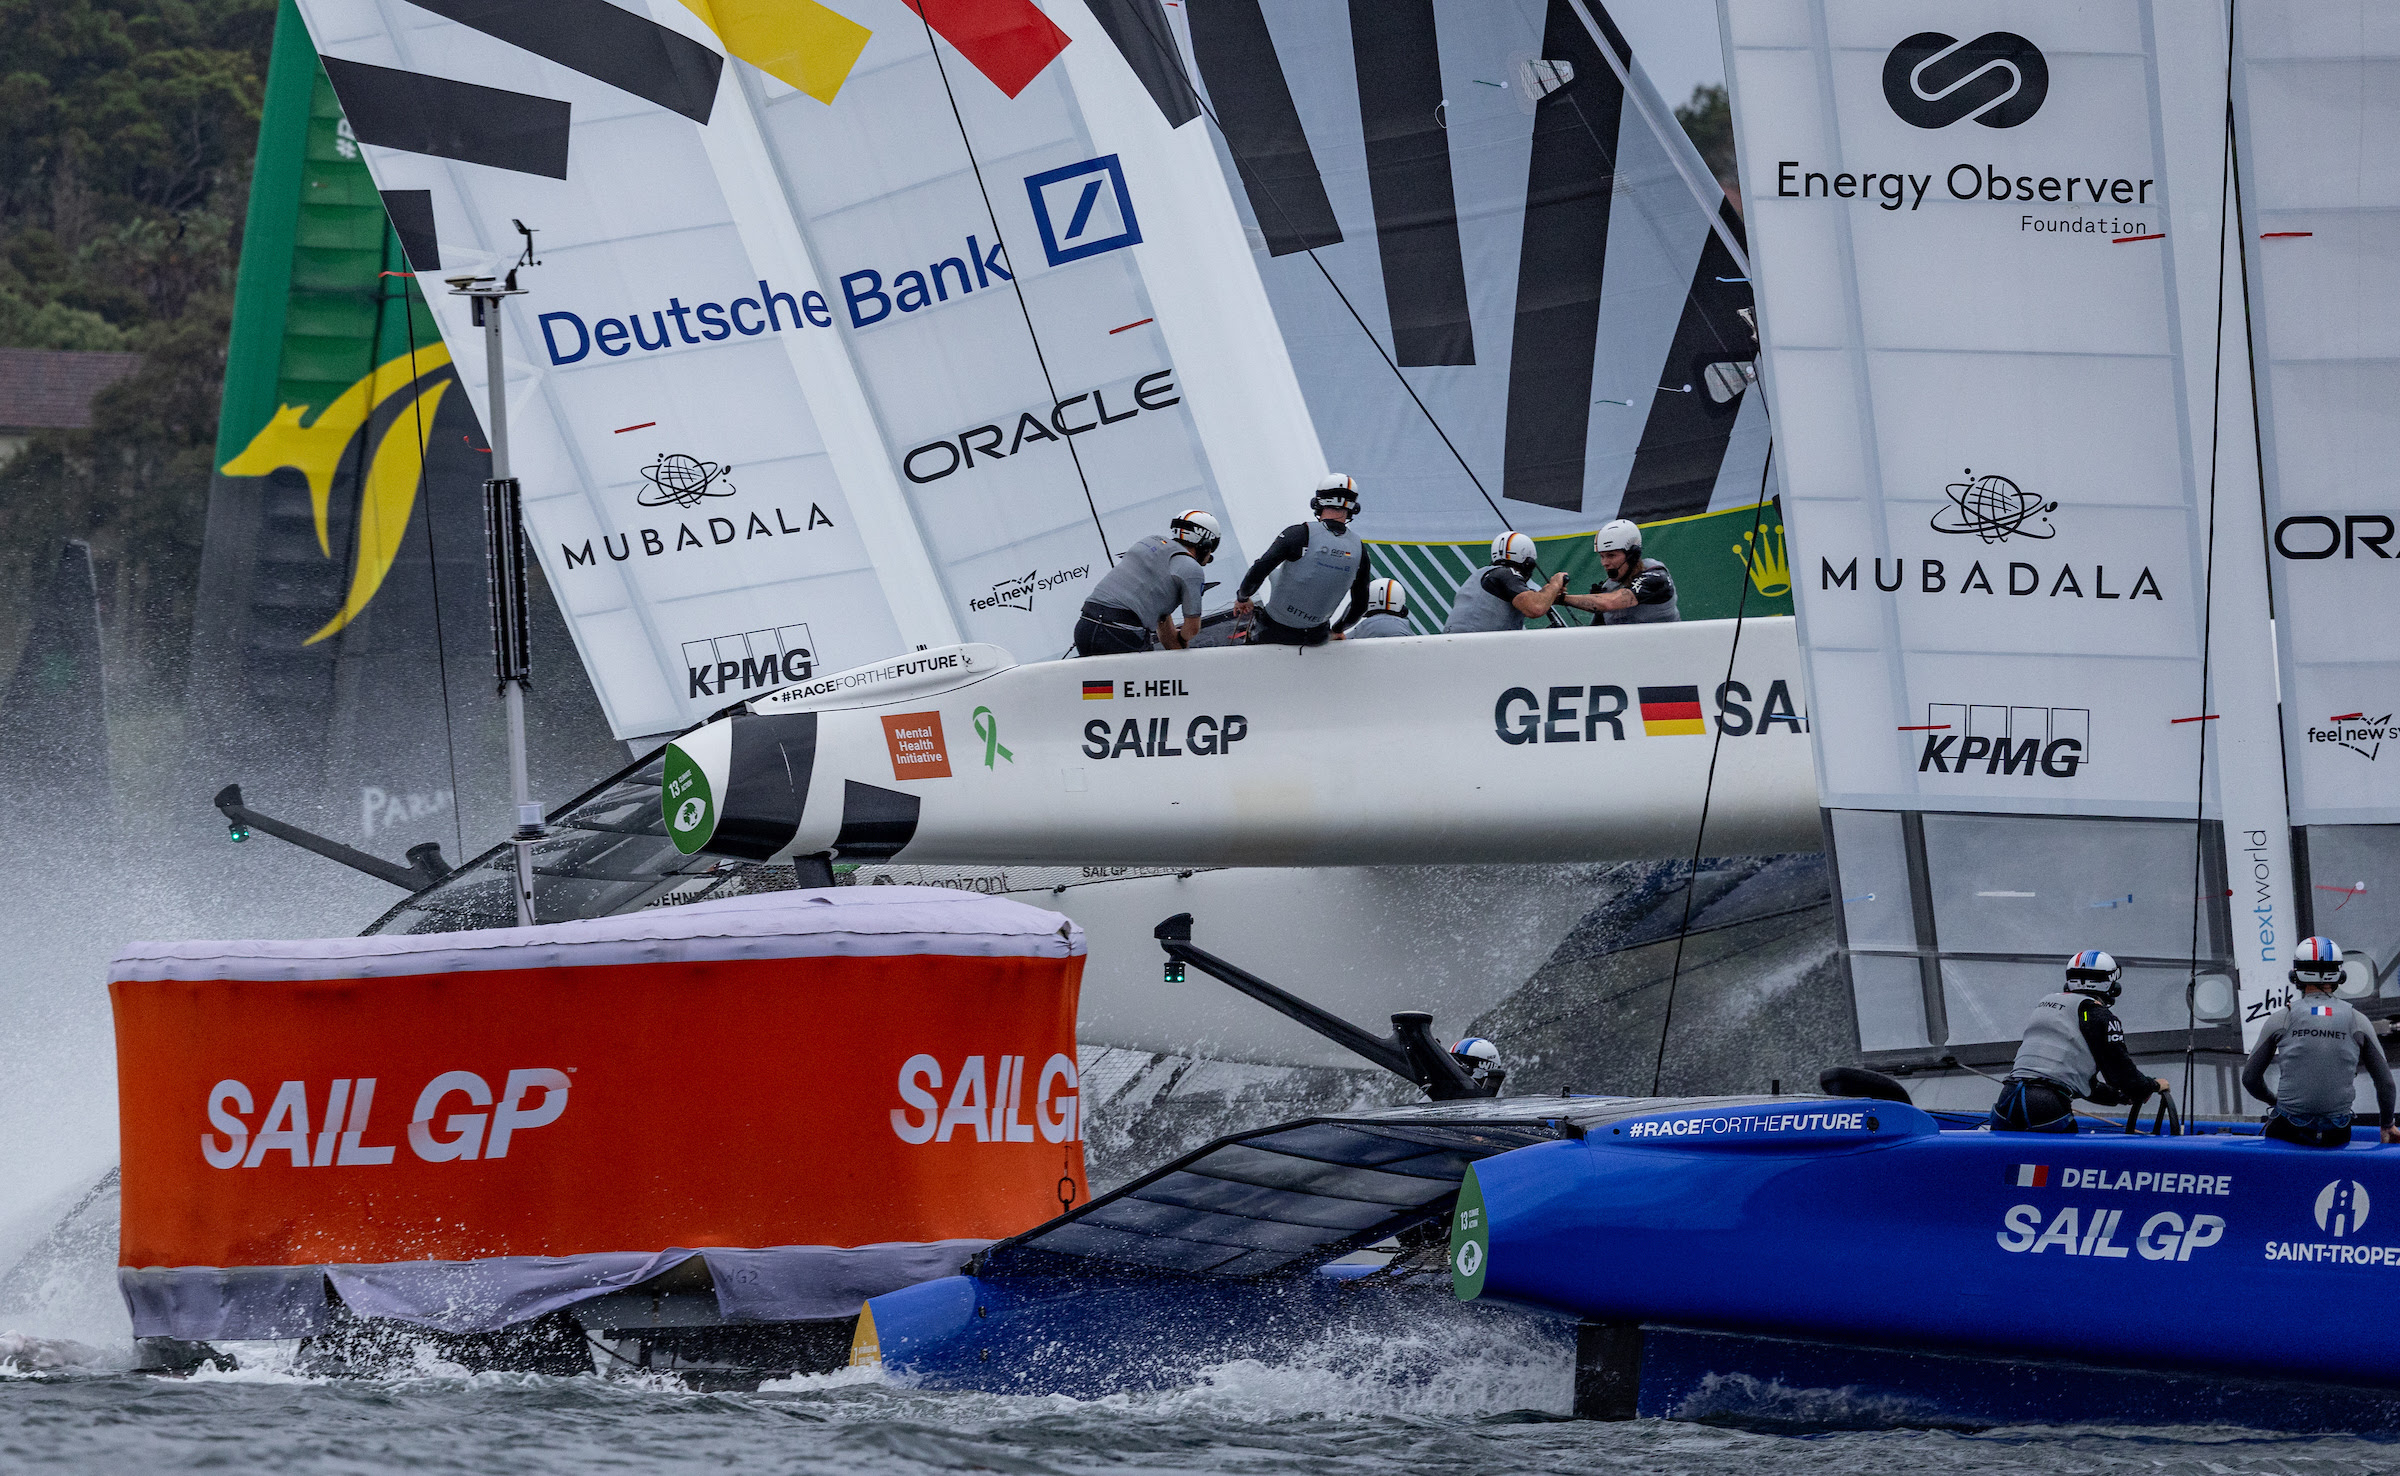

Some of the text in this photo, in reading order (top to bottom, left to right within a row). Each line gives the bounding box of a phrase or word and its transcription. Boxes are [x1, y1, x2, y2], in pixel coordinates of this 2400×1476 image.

[1777, 161, 2154, 211] Energy Observer
[2021, 215, 2147, 234] Foundation
[538, 234, 1014, 367] Deutsche Bank
[903, 368, 1181, 484] ORACLE
[561, 502, 834, 570] MUBADALA
[2274, 515, 2400, 559] OR
[969, 564, 1090, 612] feel new sydney
[1822, 556, 2163, 601] MUBADALA
[690, 648, 812, 698] KPMG
[781, 654, 958, 702] #RACEFORTHEFUTURE
[895, 725, 933, 740] Mental
[1494, 679, 1810, 745] GER SA
[2307, 723, 2342, 743] feel
[2346, 727, 2385, 740] new
[895, 752, 943, 765] Initiative
[898, 738, 934, 752] Health
[1918, 734, 2082, 778] KPMG
[668, 780, 681, 799] 13
[2243, 829, 2276, 962] nextworld
[2292, 1029, 2347, 1040] PEPONNET
[890, 1053, 1083, 1145] SAILG
[1629, 1113, 1864, 1138] #RACEFORTHEFUTURE
[2061, 1167, 2232, 1196] DELAPIERRE
[1460, 1211, 1468, 1231] 13
